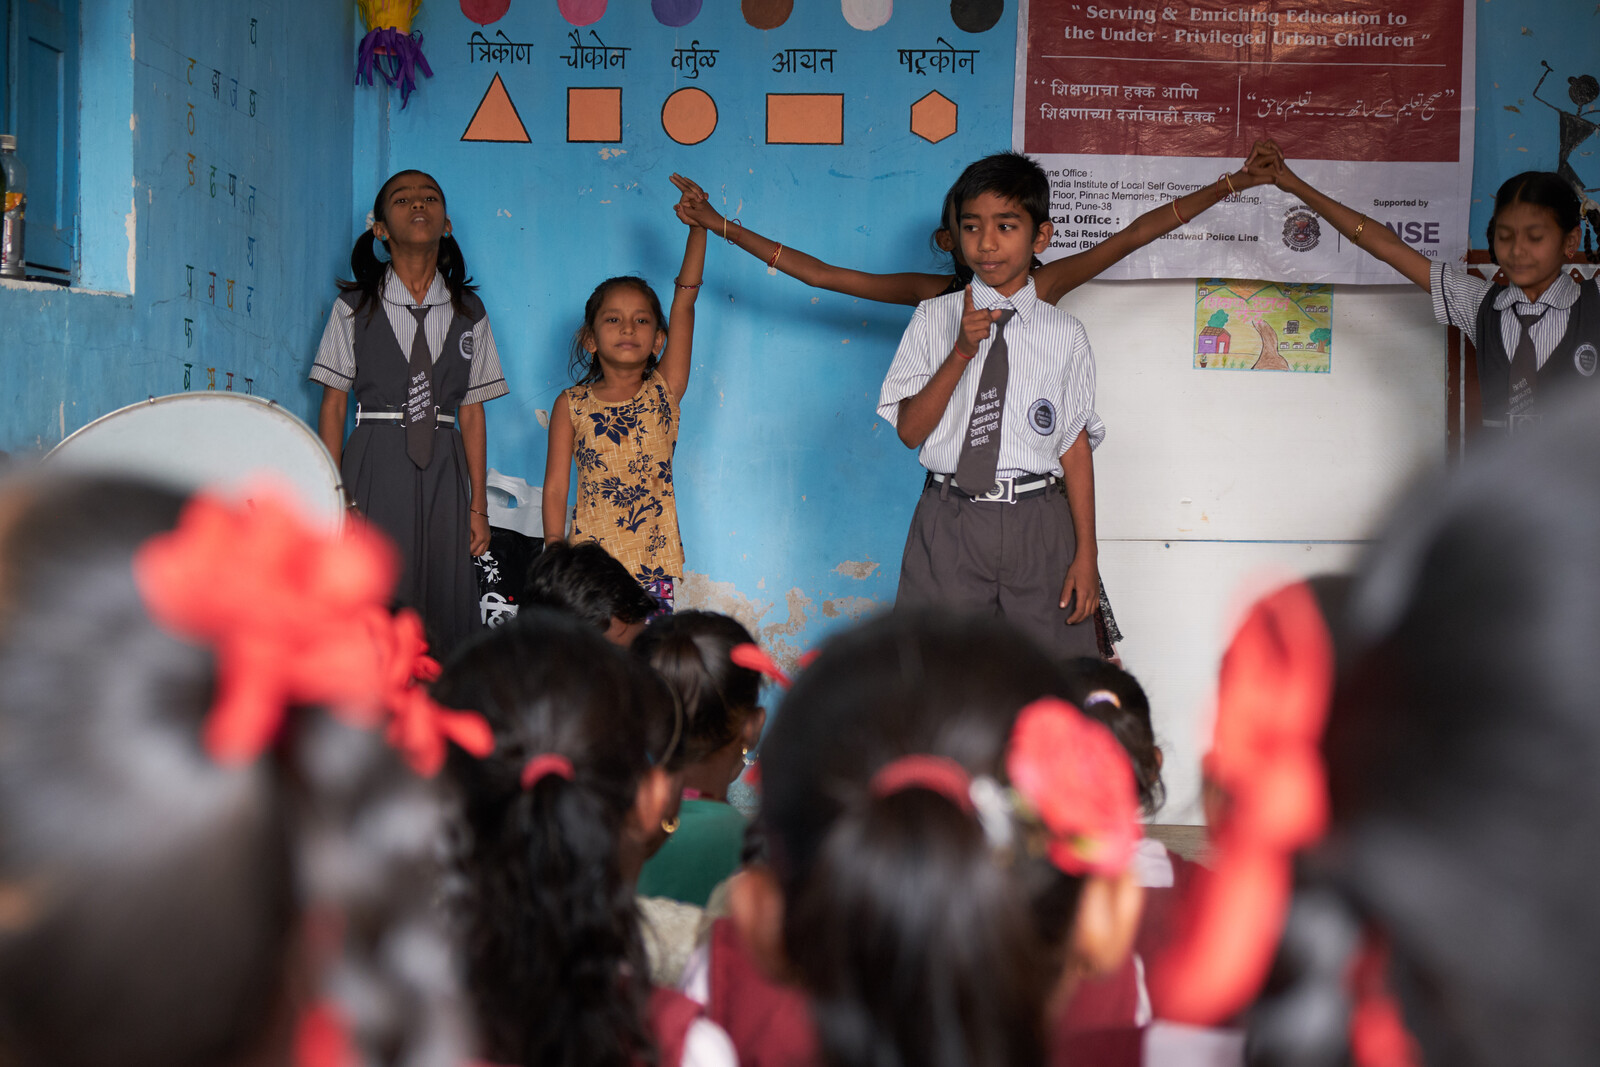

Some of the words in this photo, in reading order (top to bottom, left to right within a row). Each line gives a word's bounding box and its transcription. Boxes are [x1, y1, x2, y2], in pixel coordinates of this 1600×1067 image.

[1086, 6, 1156, 24] Serving
[1162, 7, 1178, 20] &
[1190, 8, 1279, 26] Enriching
[1286, 10, 1380, 25] Education
[1387, 13, 1408, 25] to
[1064, 26, 1094, 40] the
[1101, 27, 1155, 42] Under
[1175, 30, 1266, 48] Privileged
[1273, 32, 1328, 46] Urban
[1334, 32, 1414, 47] Children
[467, 30, 534, 64] त्रिकोण
[560, 28, 632, 70] चौकोन
[670, 40, 720, 79] वर्तुळ
[772, 49, 838, 74] आयत
[1050, 78, 1120, 96] शिक्षणाचा
[1122, 86, 1156, 100] हक्क
[1162, 82, 1200, 100] आणि
[1040, 102, 1112, 121] शिक्षणाच्या
[1044, 170, 1060, 178] une
[1062, 168, 1088, 178] Office
[1050, 180, 1071, 188] India
[1074, 180, 1108, 188] Institute
[1110, 180, 1120, 188] of
[1121, 181, 1144, 190] Local
[1147, 182, 1164, 190] Self
[1048, 202, 1072, 210] thrud,
[1075, 202, 1112, 210] Pune-38
[1052, 191, 1076, 200] Floor,
[1080, 191, 1110, 200] Pinnac
[1112, 192, 1157, 202] Memories,
[1224, 195, 1262, 205] Building,
[1373, 199, 1416, 208] Supported
[1418, 199, 1429, 208] by
[1050, 214, 1070, 224] cal
[1074, 215, 1112, 224] Office
[1048, 240, 1076, 248] adwad
[1064, 230, 1078, 238] Sai
[1206, 232, 1235, 241] Police
[1238, 234, 1258, 242] Line
